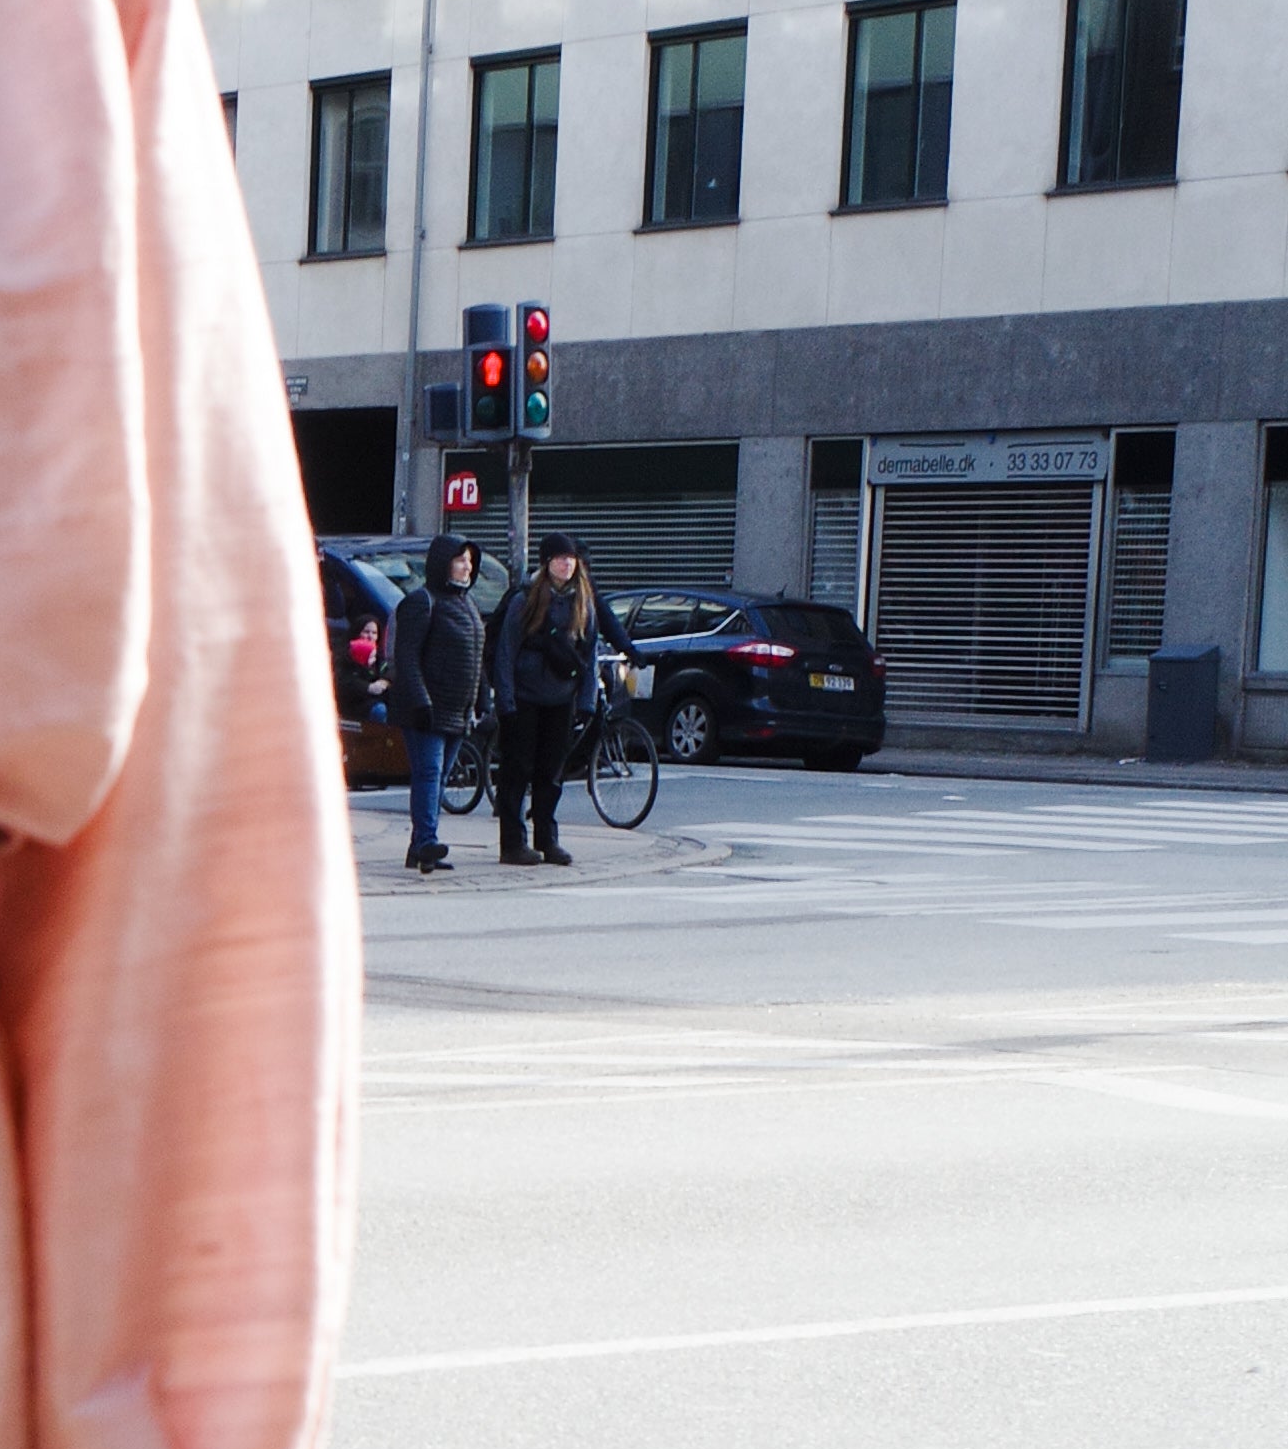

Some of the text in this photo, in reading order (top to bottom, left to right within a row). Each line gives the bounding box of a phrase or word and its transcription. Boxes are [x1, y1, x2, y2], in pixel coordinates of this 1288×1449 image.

[877, 451, 1098, 474] dermabelle.dk 33 33 07 73
